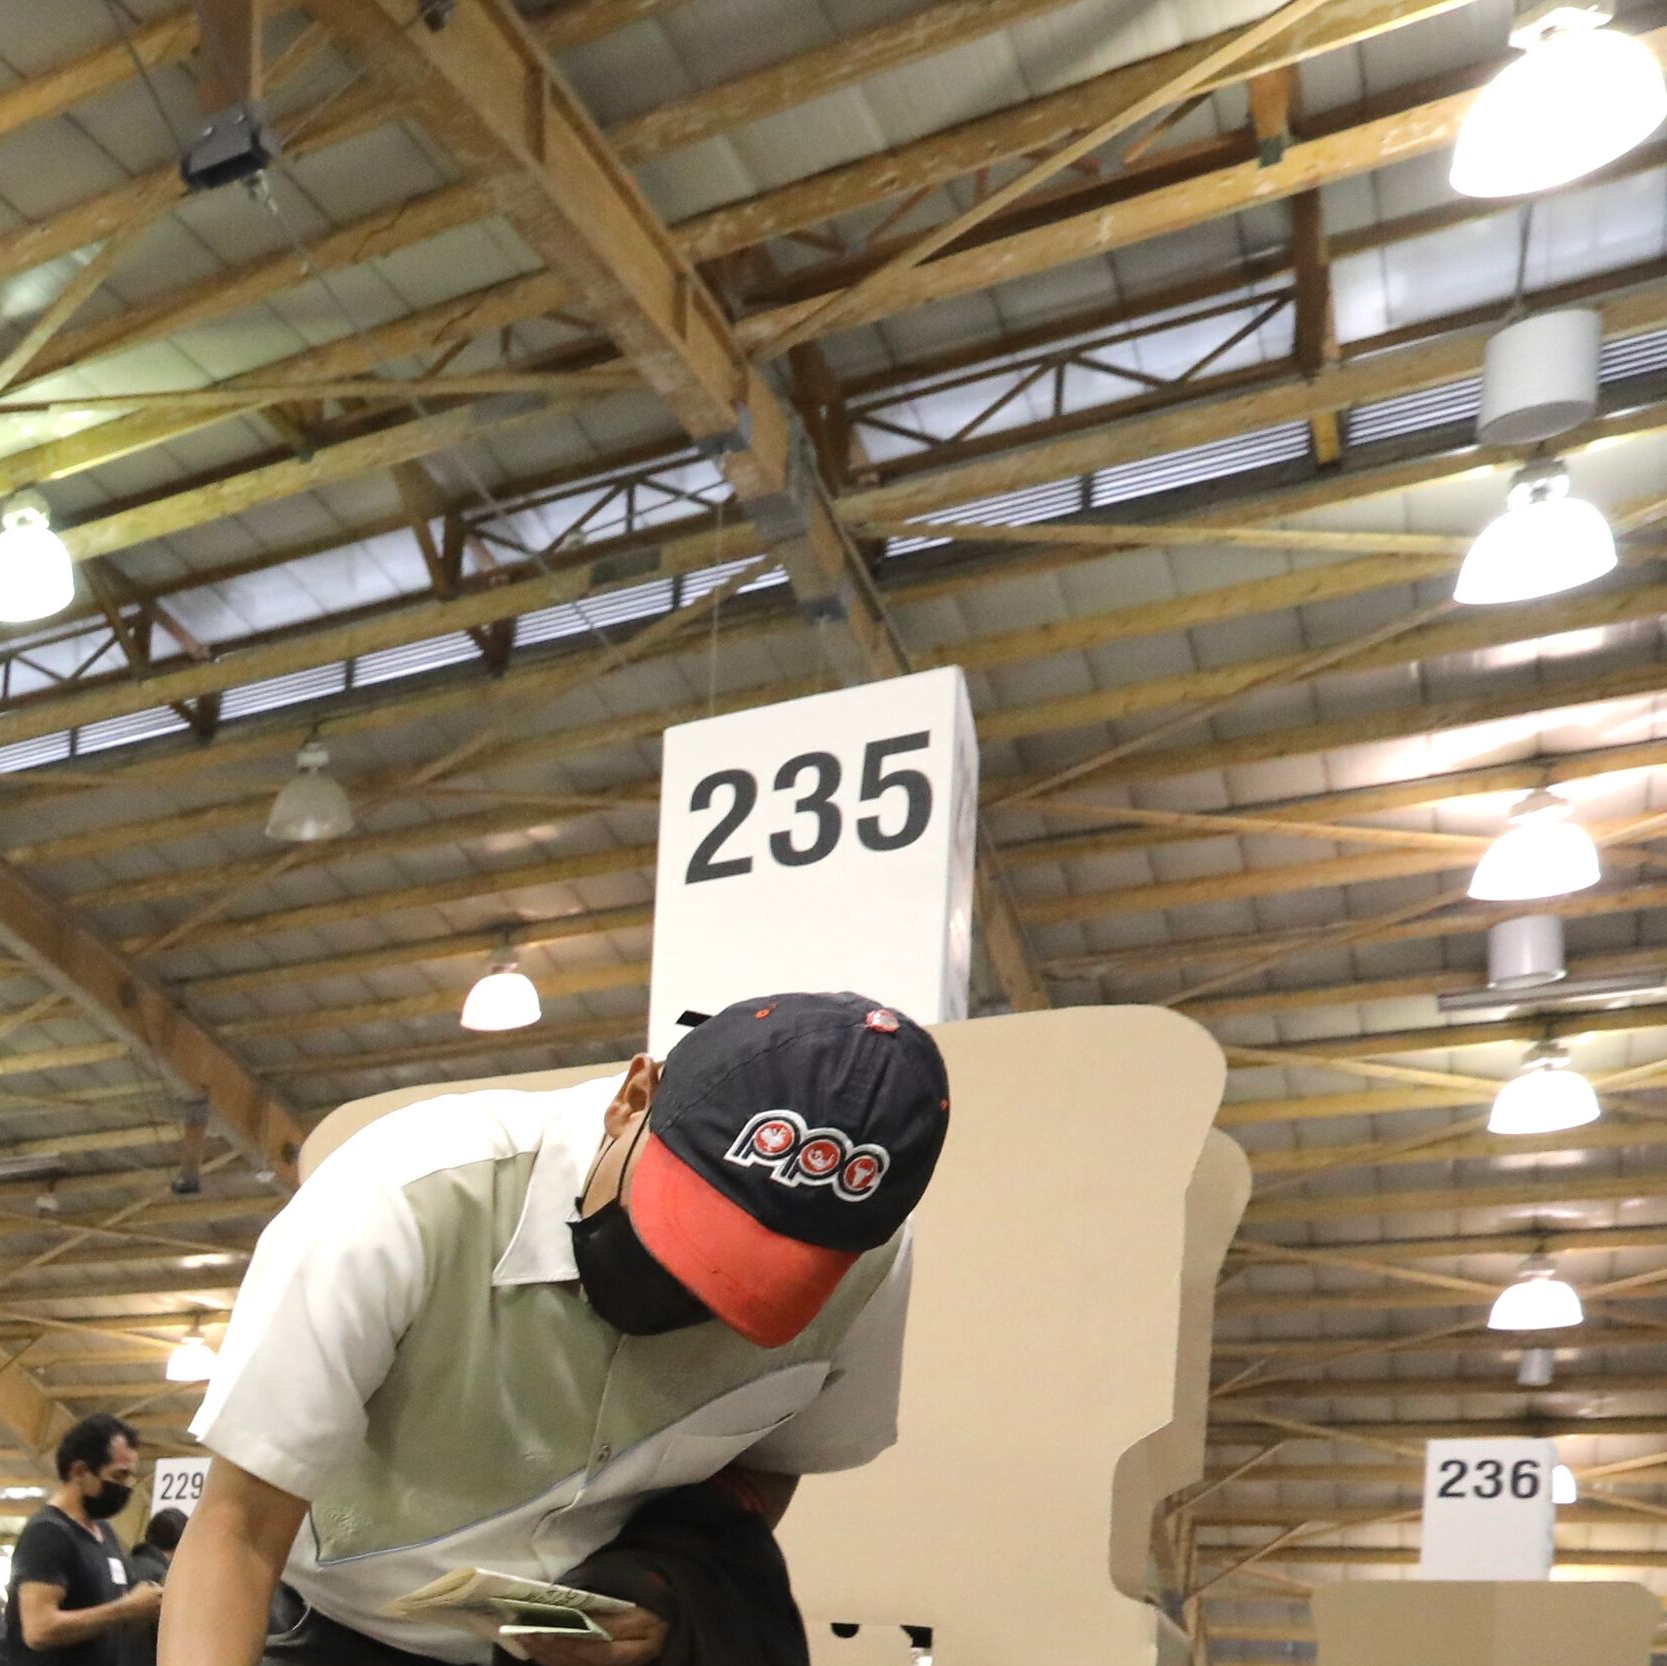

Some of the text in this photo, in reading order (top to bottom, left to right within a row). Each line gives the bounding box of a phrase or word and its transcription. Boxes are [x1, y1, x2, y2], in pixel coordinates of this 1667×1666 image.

[685, 729, 933, 885] 235
[161, 1471, 204, 1500] 229
[1438, 1459, 1540, 1499] 236
